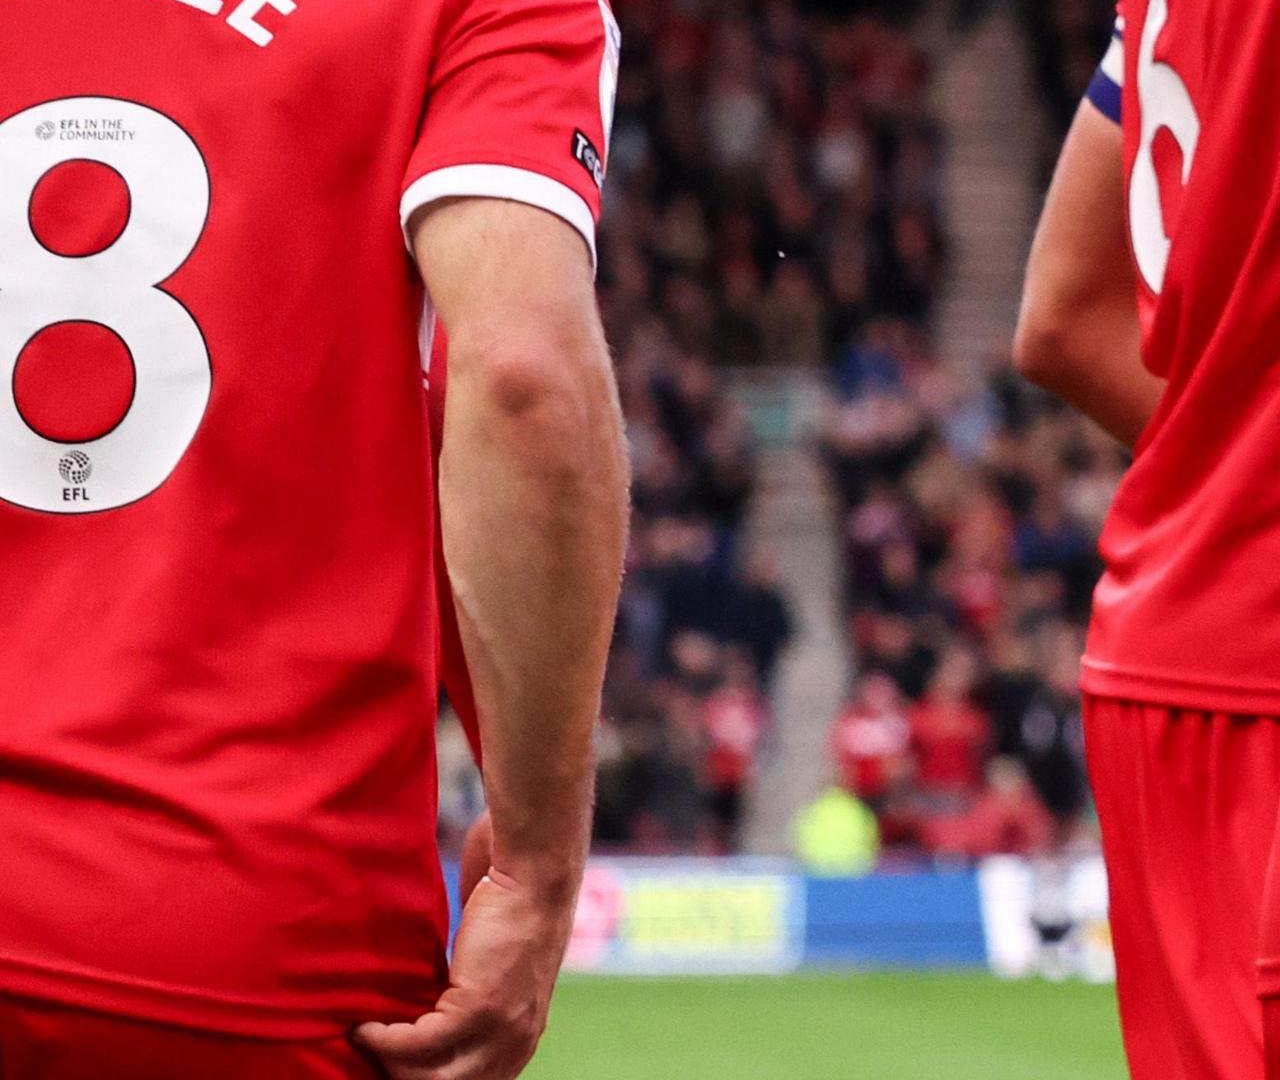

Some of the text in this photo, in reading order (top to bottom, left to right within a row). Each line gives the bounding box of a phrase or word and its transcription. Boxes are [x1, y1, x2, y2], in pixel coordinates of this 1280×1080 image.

[60, 119, 123, 130] EFL IN THE
[60, 130, 136, 141] COMMUNITY
[0, 95, 213, 514] 8
[63, 487, 90, 501] EFL
